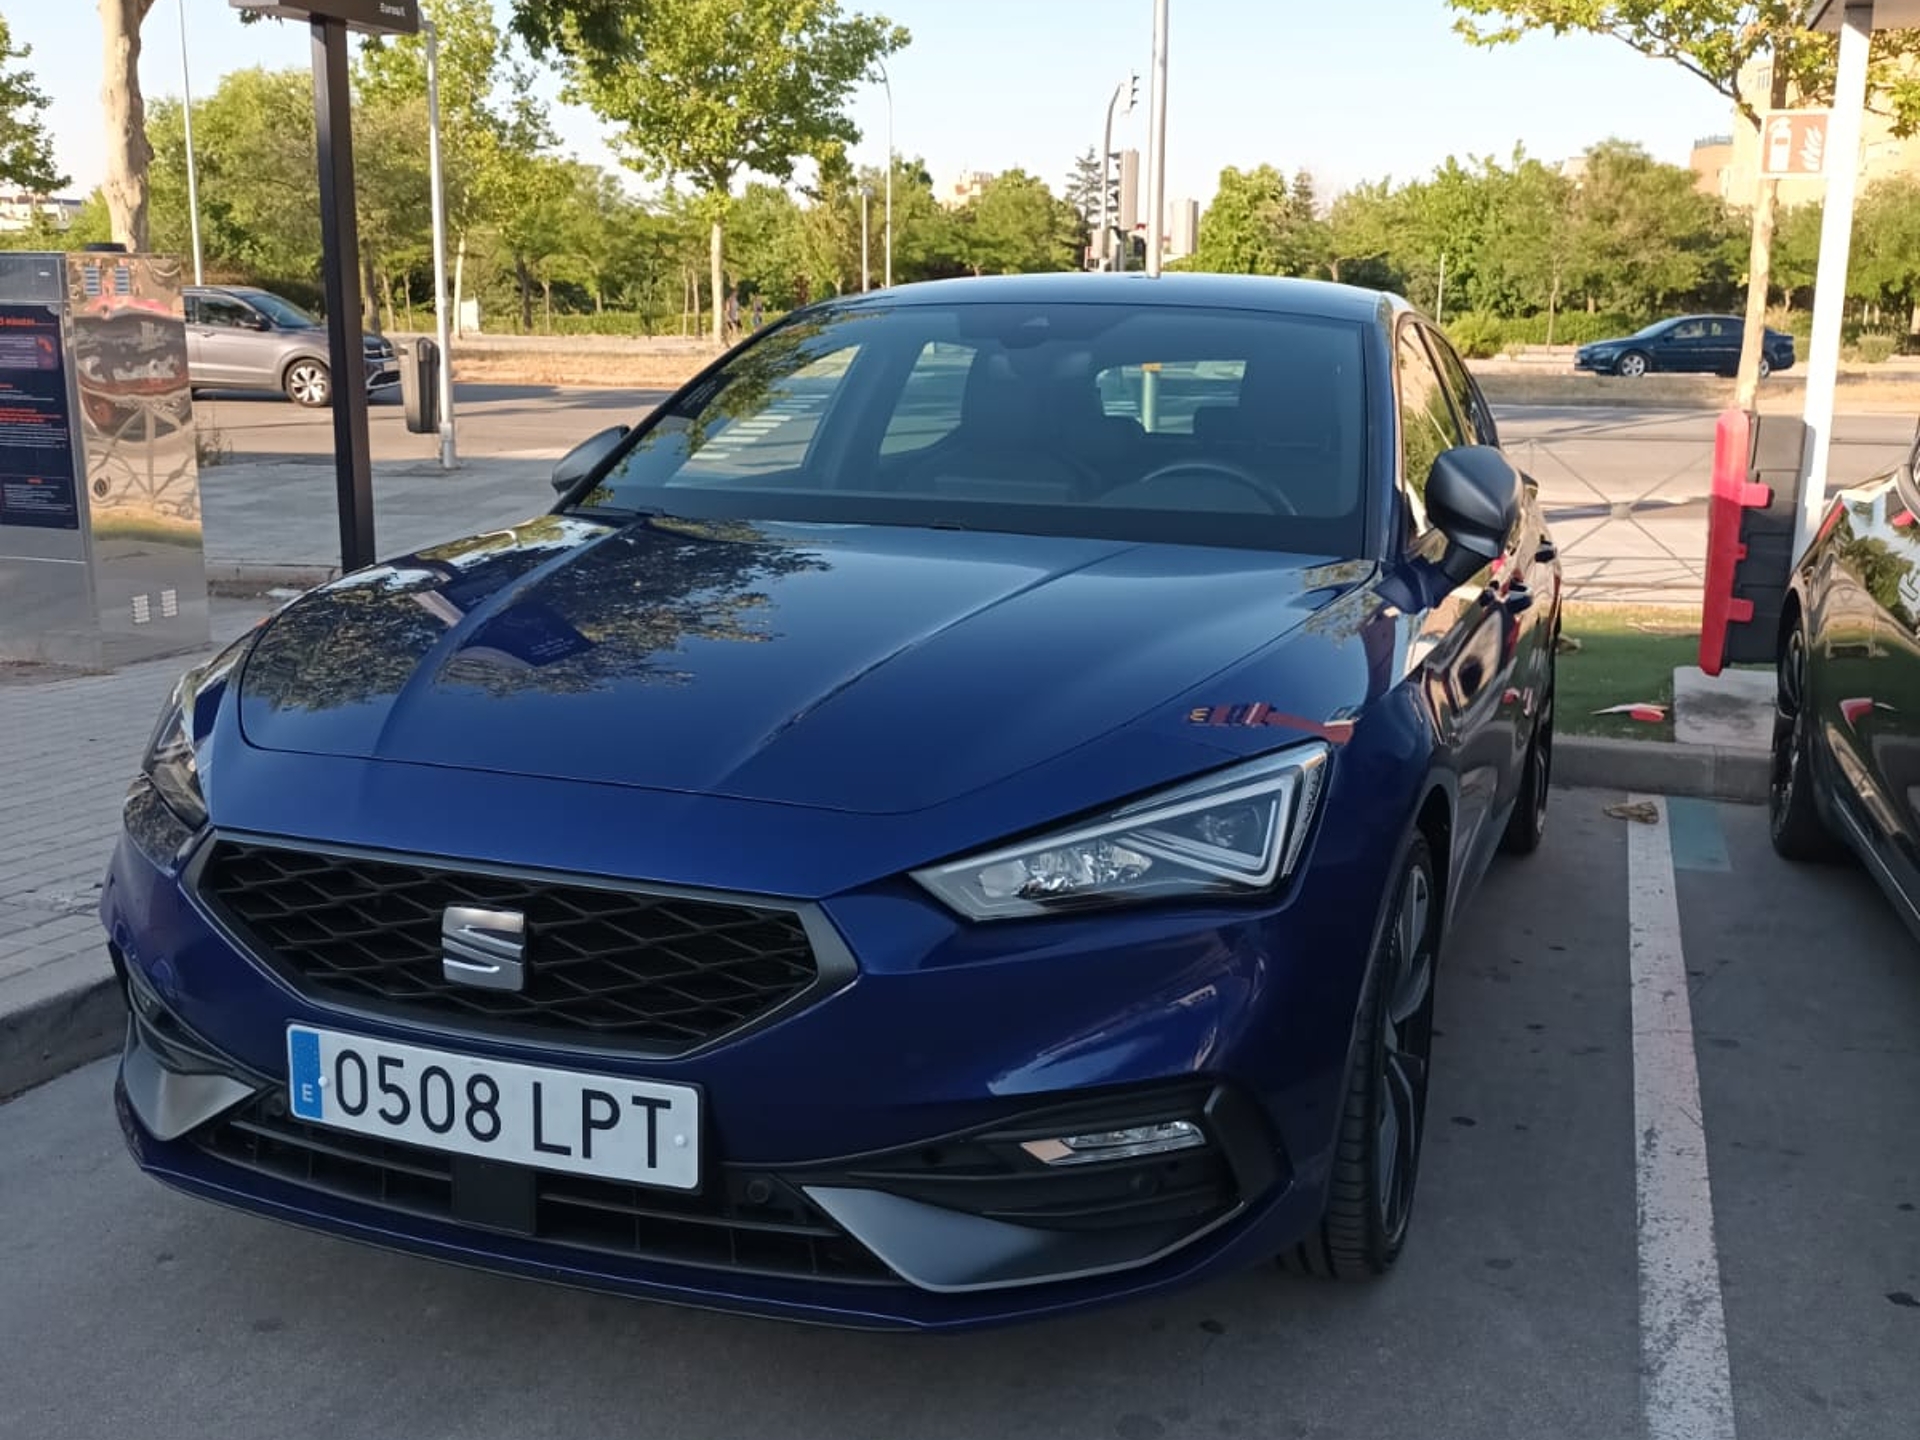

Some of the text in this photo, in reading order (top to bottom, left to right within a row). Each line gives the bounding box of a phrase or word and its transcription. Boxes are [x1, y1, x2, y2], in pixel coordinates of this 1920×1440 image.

[302, 1083, 314, 1103] E
[335, 1049, 672, 1168] 0508 LPT
